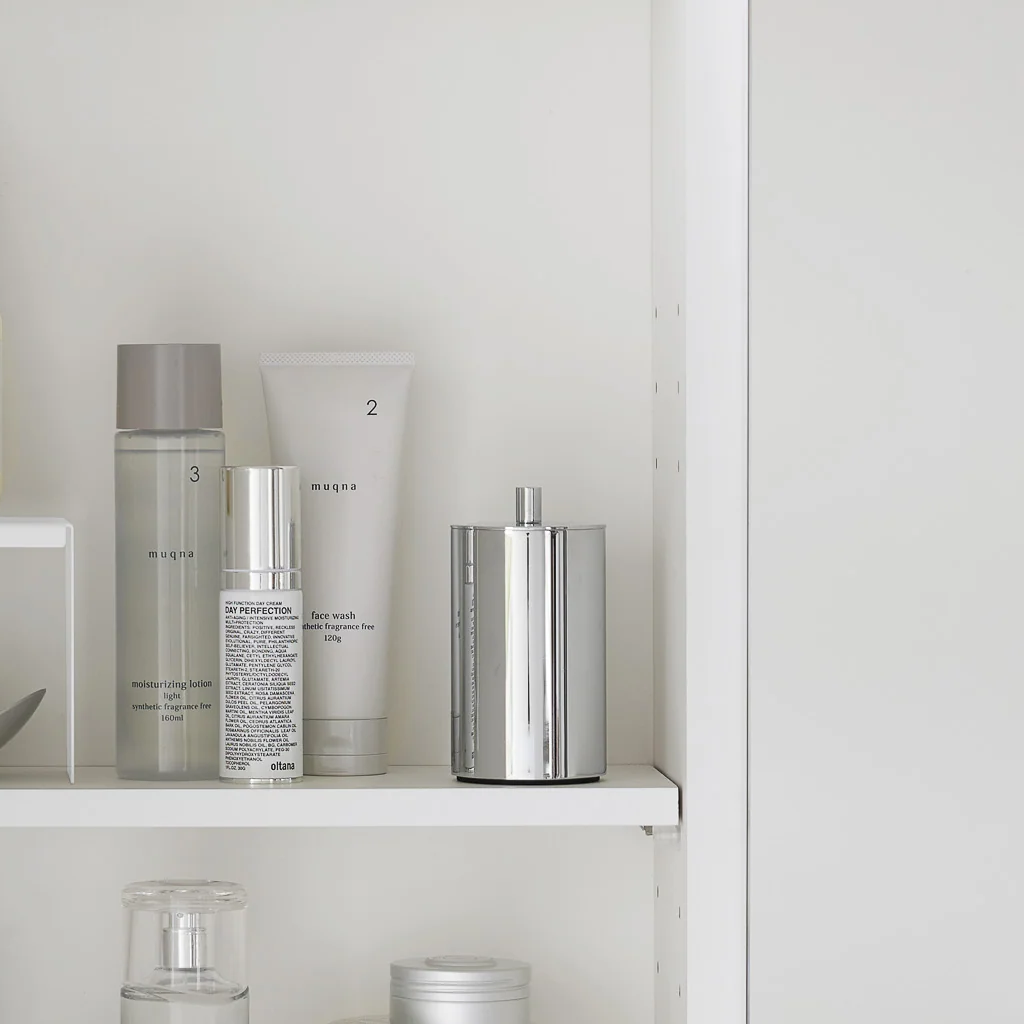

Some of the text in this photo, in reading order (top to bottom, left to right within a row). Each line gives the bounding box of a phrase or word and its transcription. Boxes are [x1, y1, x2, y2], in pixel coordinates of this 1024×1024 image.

[366, 400, 378, 416] 2
[190, 466, 200, 482] 3
[311, 482, 357, 493] muqna
[148, 550, 194, 560] muqna
[239, 606, 292, 614] PERFECTION
[311, 610, 356, 620] face wash
[325, 623, 360, 631] fragrance
[324, 634, 342, 643] 120g
[132, 680, 212, 690] moisturizing lotion
[163, 692, 181, 701] light
[132, 702, 162, 711] synthetic
[164, 702, 198, 712] fragrance
[271, 761, 295, 770] oltana
